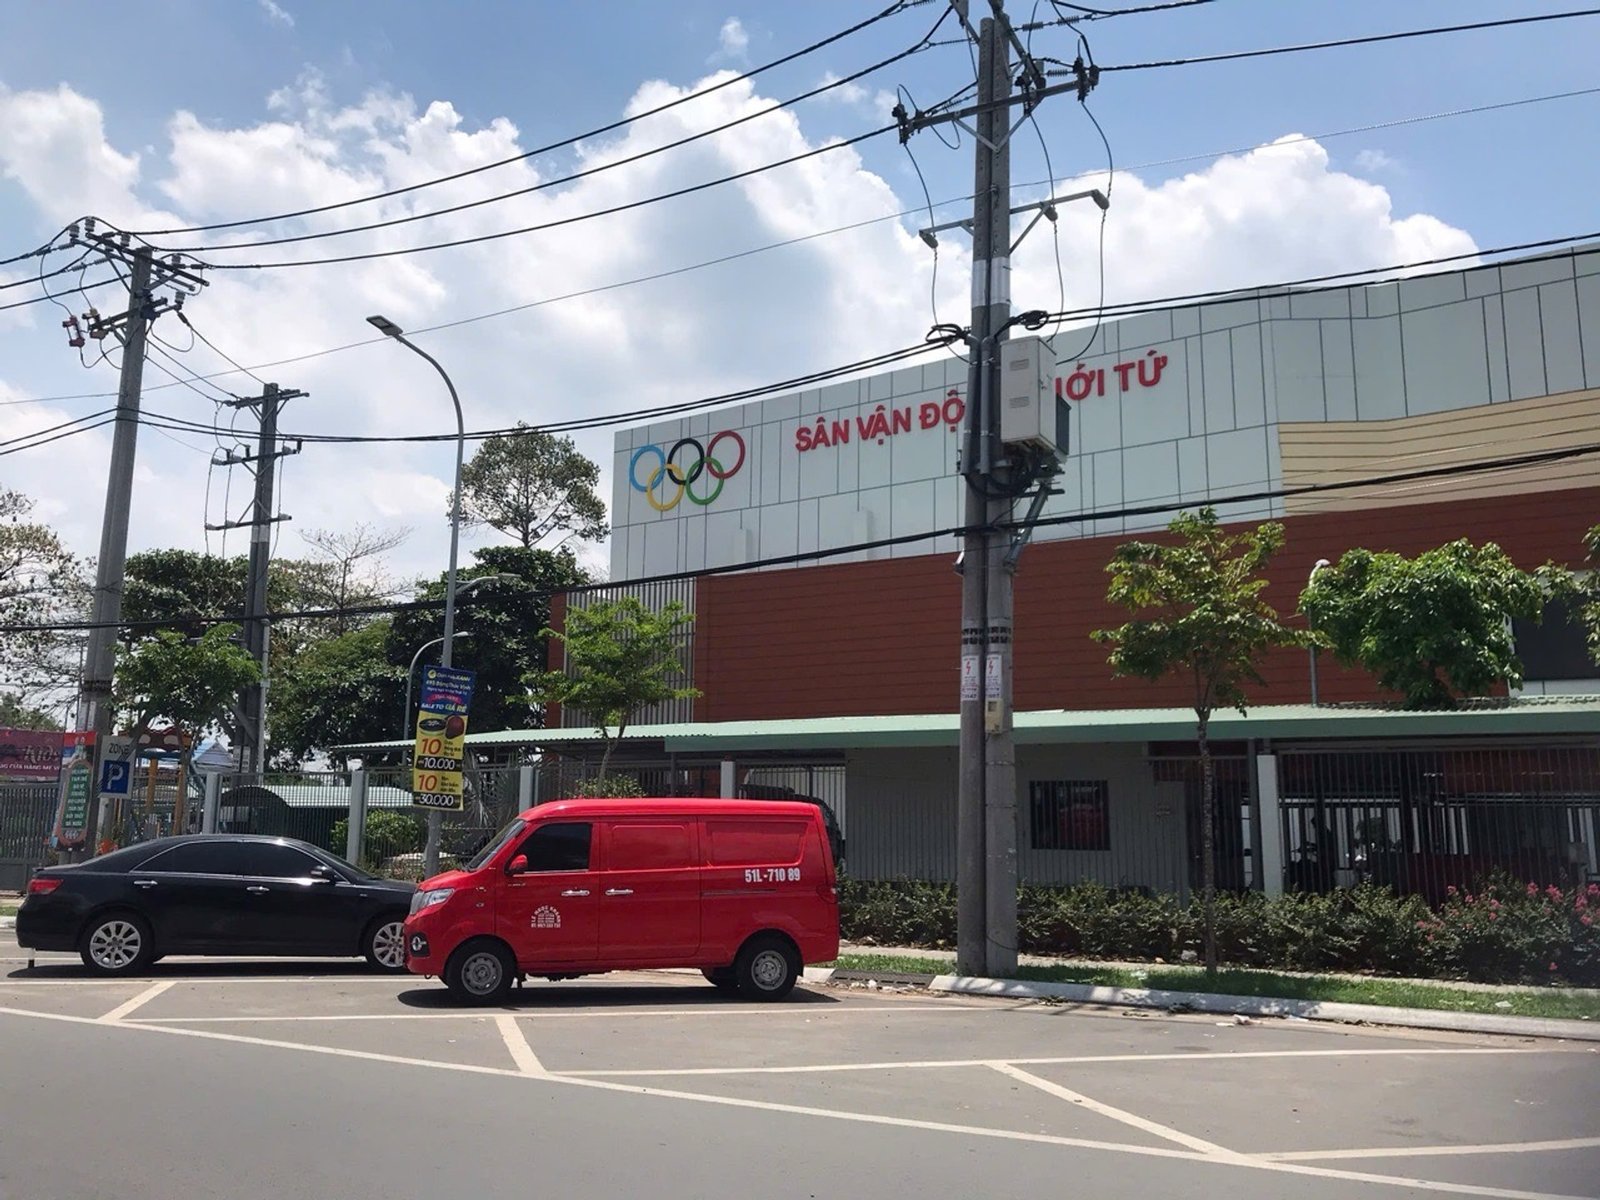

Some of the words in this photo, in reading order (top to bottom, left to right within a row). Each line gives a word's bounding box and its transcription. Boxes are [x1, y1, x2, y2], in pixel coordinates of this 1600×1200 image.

[795, 416, 850, 452] SÂN
[856, 404, 911, 446] VẬN
[918, 389, 965, 433] ĐỘ
[1055, 363, 1105, 401] ỚI
[1113, 349, 1168, 392] TỨ
[109, 742, 130, 755] ZONE
[422, 738, 442, 755] 10
[424, 757, 455, 770] 10.000
[107, 763, 124, 790] P
[419, 774, 438, 792] 10
[419, 793, 454, 807] 30.000
[745, 868, 785, 882] 51L-710
[788, 867, 800, 881] 89
